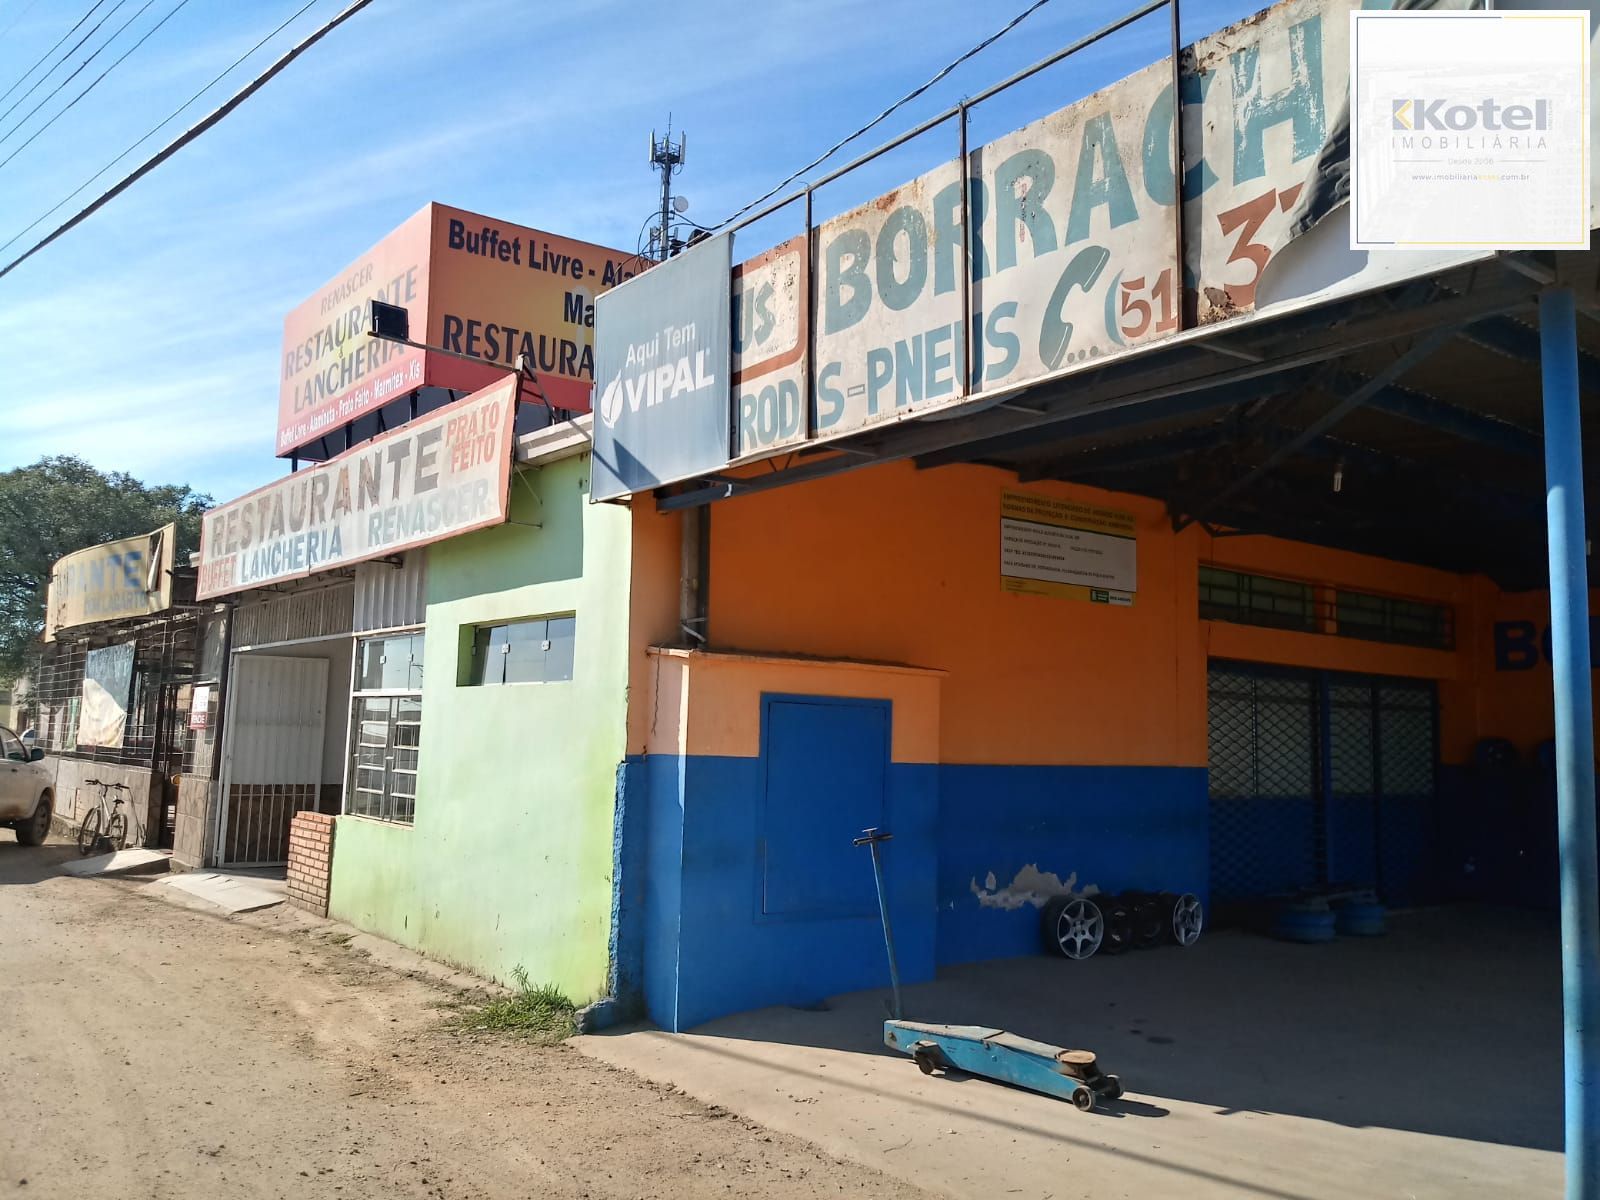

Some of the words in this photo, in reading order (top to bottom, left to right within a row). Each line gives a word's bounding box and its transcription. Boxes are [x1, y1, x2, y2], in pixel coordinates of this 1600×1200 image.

[825, 12, 1329, 336] BORRACH
[448, 218, 521, 267] Buffet
[529, 239, 583, 280] Livre
[320, 262, 374, 315] RENASCER
[294, 338, 406, 414] LANCHERIA
[625, 332, 659, 368] Aqui
[664, 322, 695, 352] Tem
[339, 399, 354, 417] Prato
[354, 388, 370, 409] Feito
[374, 370, 404, 399] Marmitex
[409, 360, 420, 381] Xis
[625, 349, 715, 413] VIPAL
[446, 401, 500, 449] PRATO
[450, 431, 496, 474] FEITO
[211, 424, 444, 559] RESTAURANTE
[241, 524, 343, 583] LANCHERIA
[368, 478, 489, 548] RENASCER
